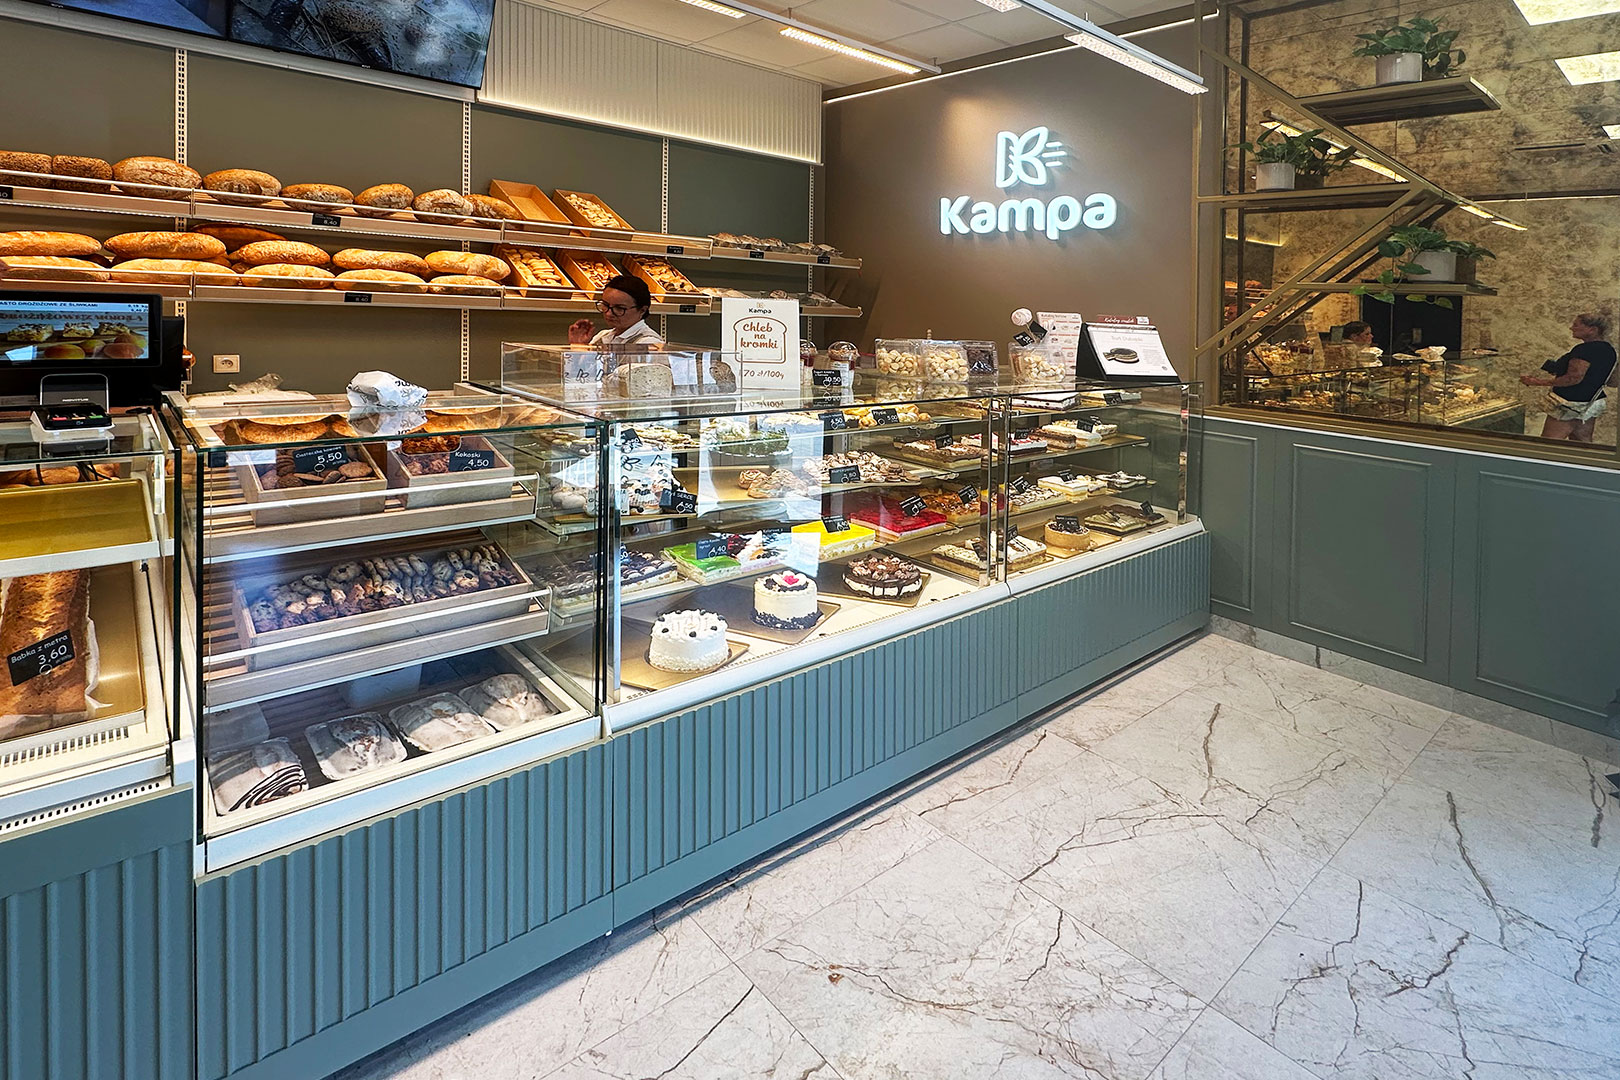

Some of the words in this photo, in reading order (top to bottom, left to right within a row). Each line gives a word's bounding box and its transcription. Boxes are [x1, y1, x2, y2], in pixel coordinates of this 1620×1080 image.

[940, 193, 1117, 240] Kampa
[742, 321, 773, 332] Chleb
[740, 337, 778, 349] kromki
[317, 451, 342, 464] 5,50
[468, 459, 490, 467] 4,50
[11, 649, 36, 663] Babka
[44, 634, 68, 649] metra
[38, 644, 68, 665] 3,60
